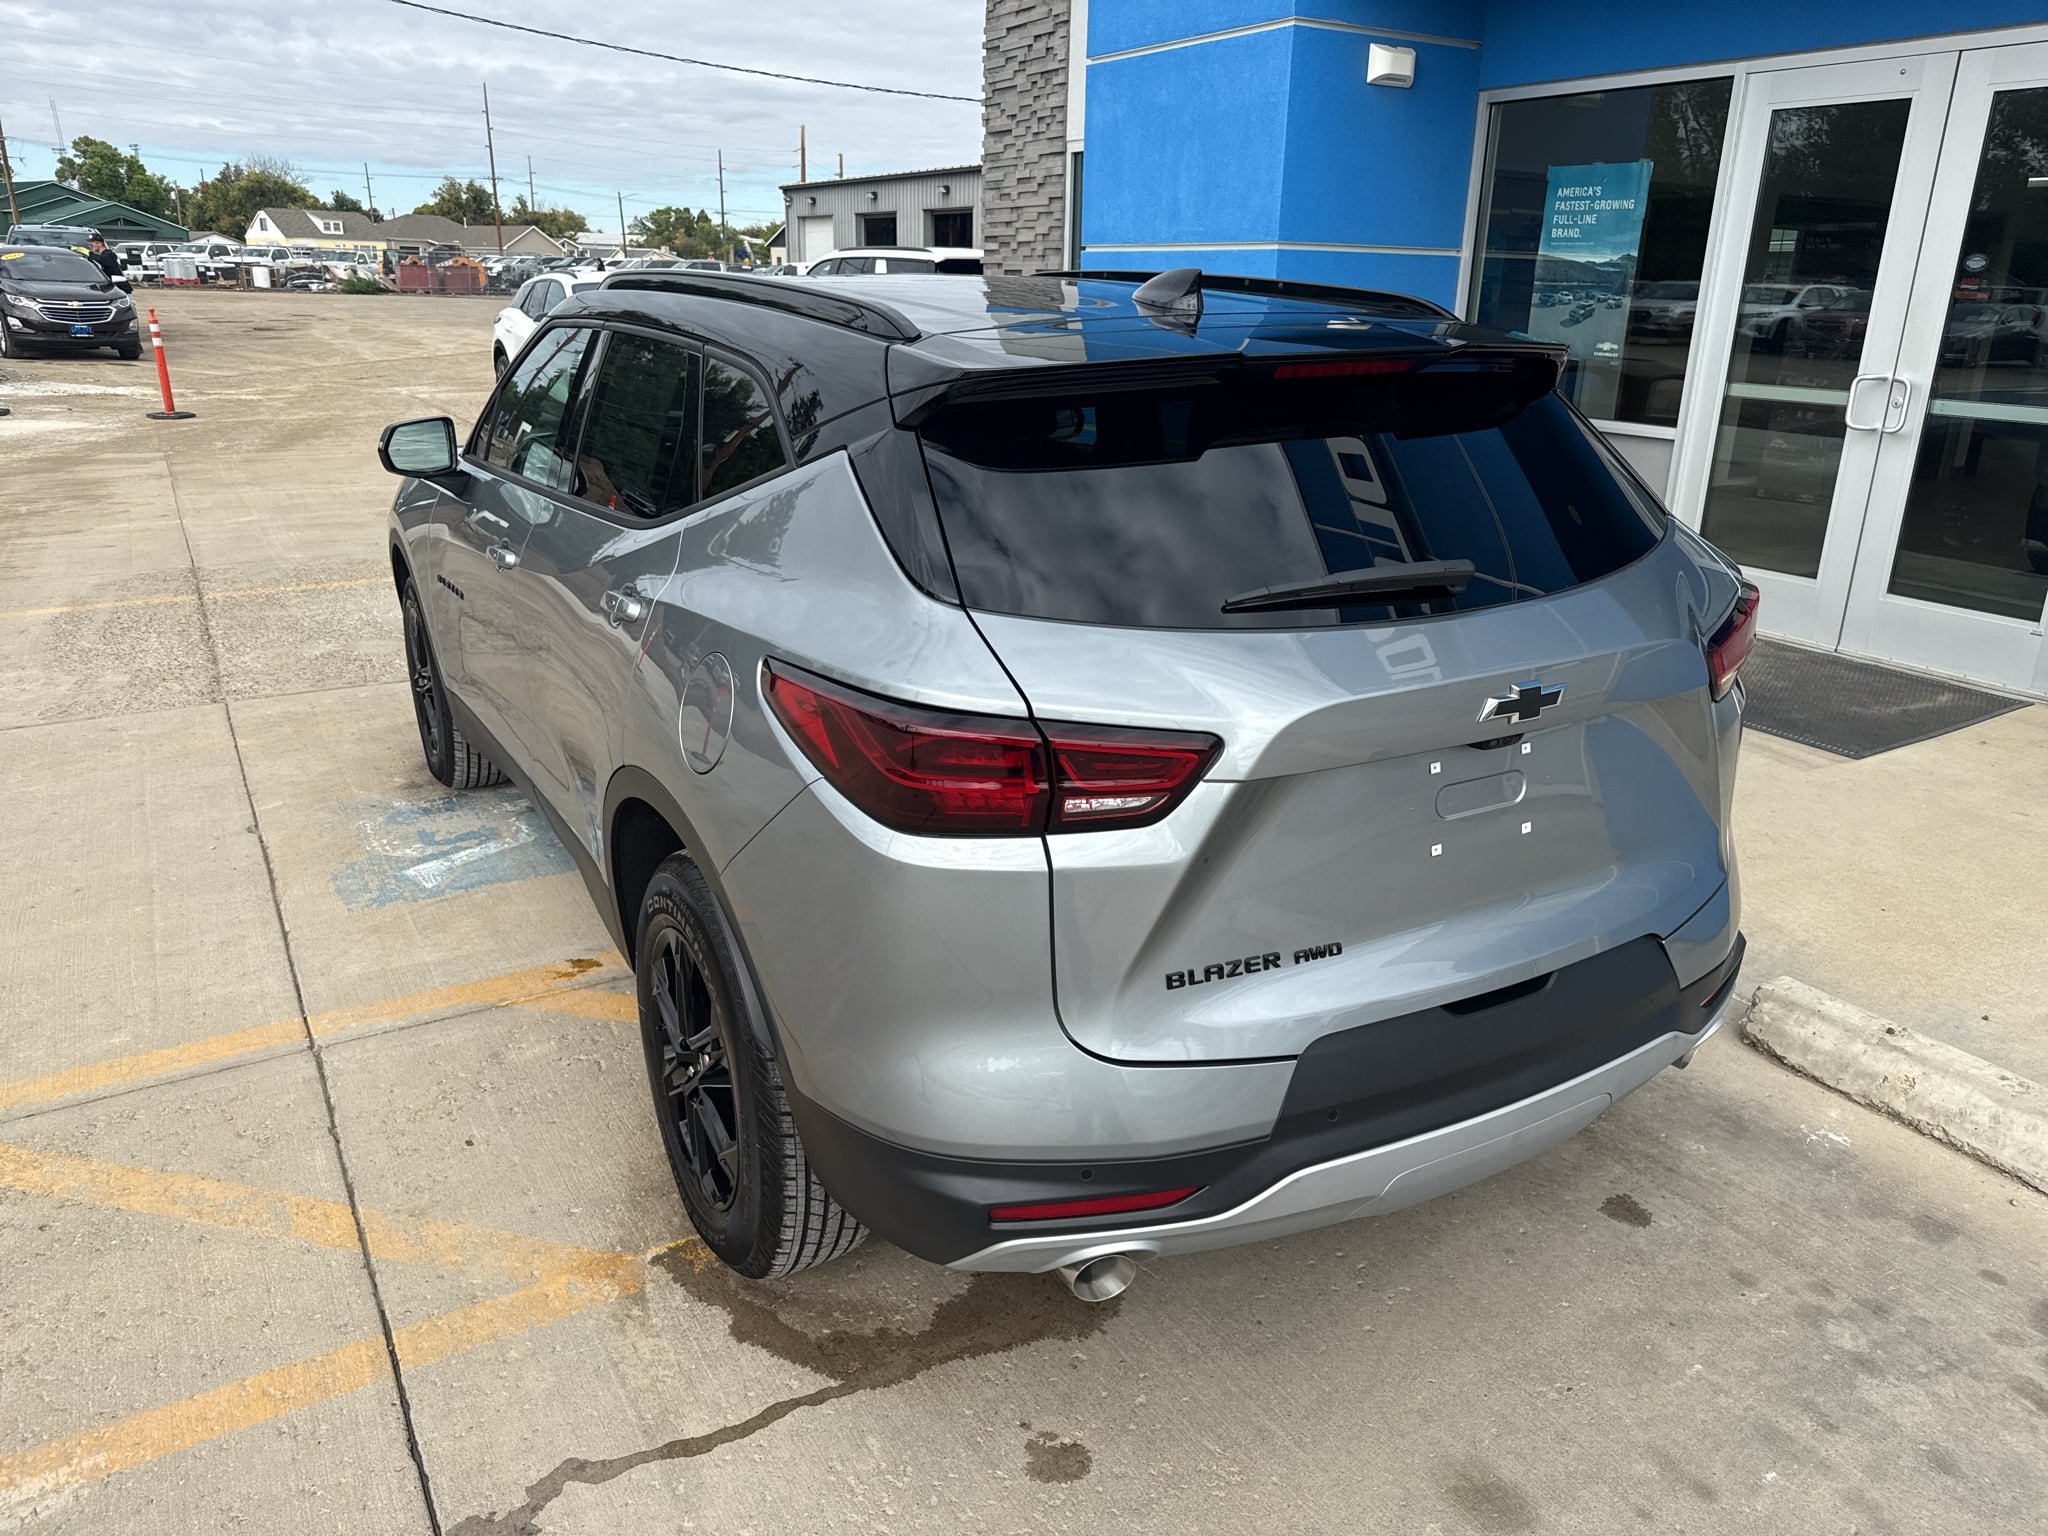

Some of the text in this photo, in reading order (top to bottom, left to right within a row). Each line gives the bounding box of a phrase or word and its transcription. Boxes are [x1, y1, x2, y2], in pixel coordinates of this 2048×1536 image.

[1557, 186, 1602, 198] AMERICA'S
[1555, 199, 1635, 211] FASTEST-GROWING
[1553, 214, 1597, 225] FULL-LINE
[1551, 228, 1582, 239] BRAND.
[1165, 941, 1343, 991] BLAZER AWD
